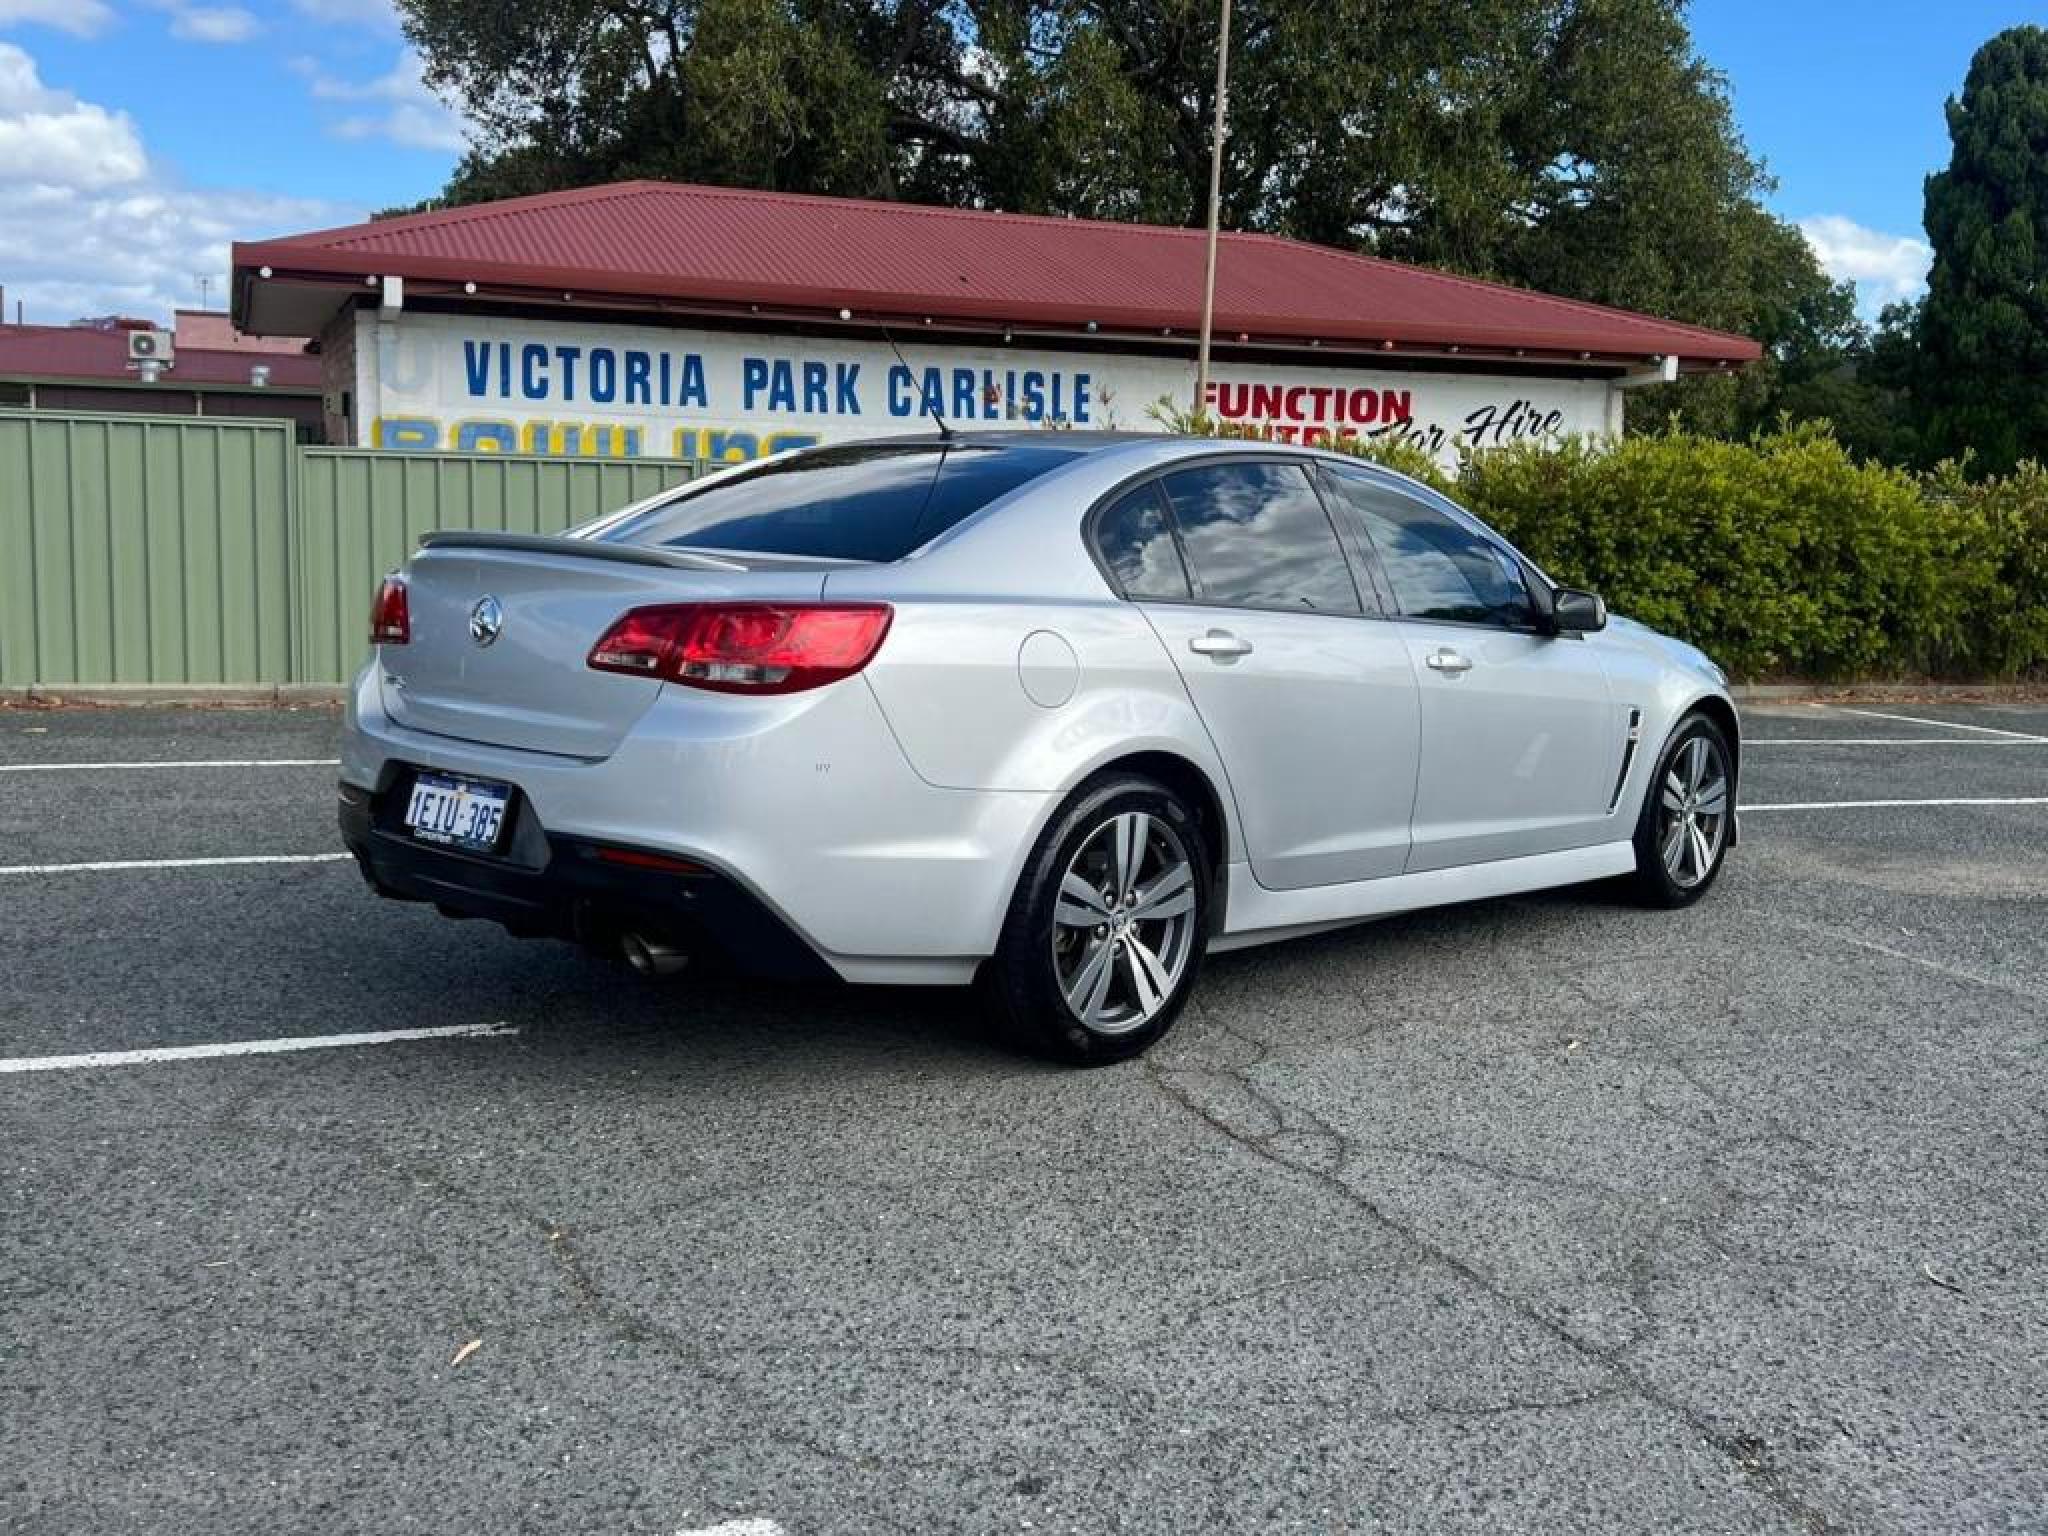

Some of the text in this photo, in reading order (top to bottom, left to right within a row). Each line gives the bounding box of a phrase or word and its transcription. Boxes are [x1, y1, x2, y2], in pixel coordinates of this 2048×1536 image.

[463, 340, 708, 408] VICTORIA
[743, 357, 862, 415] PARK
[887, 364, 1091, 423] CARLISLE
[1194, 381, 1412, 425] FUNCTION
[1463, 400, 1563, 446] Hire
